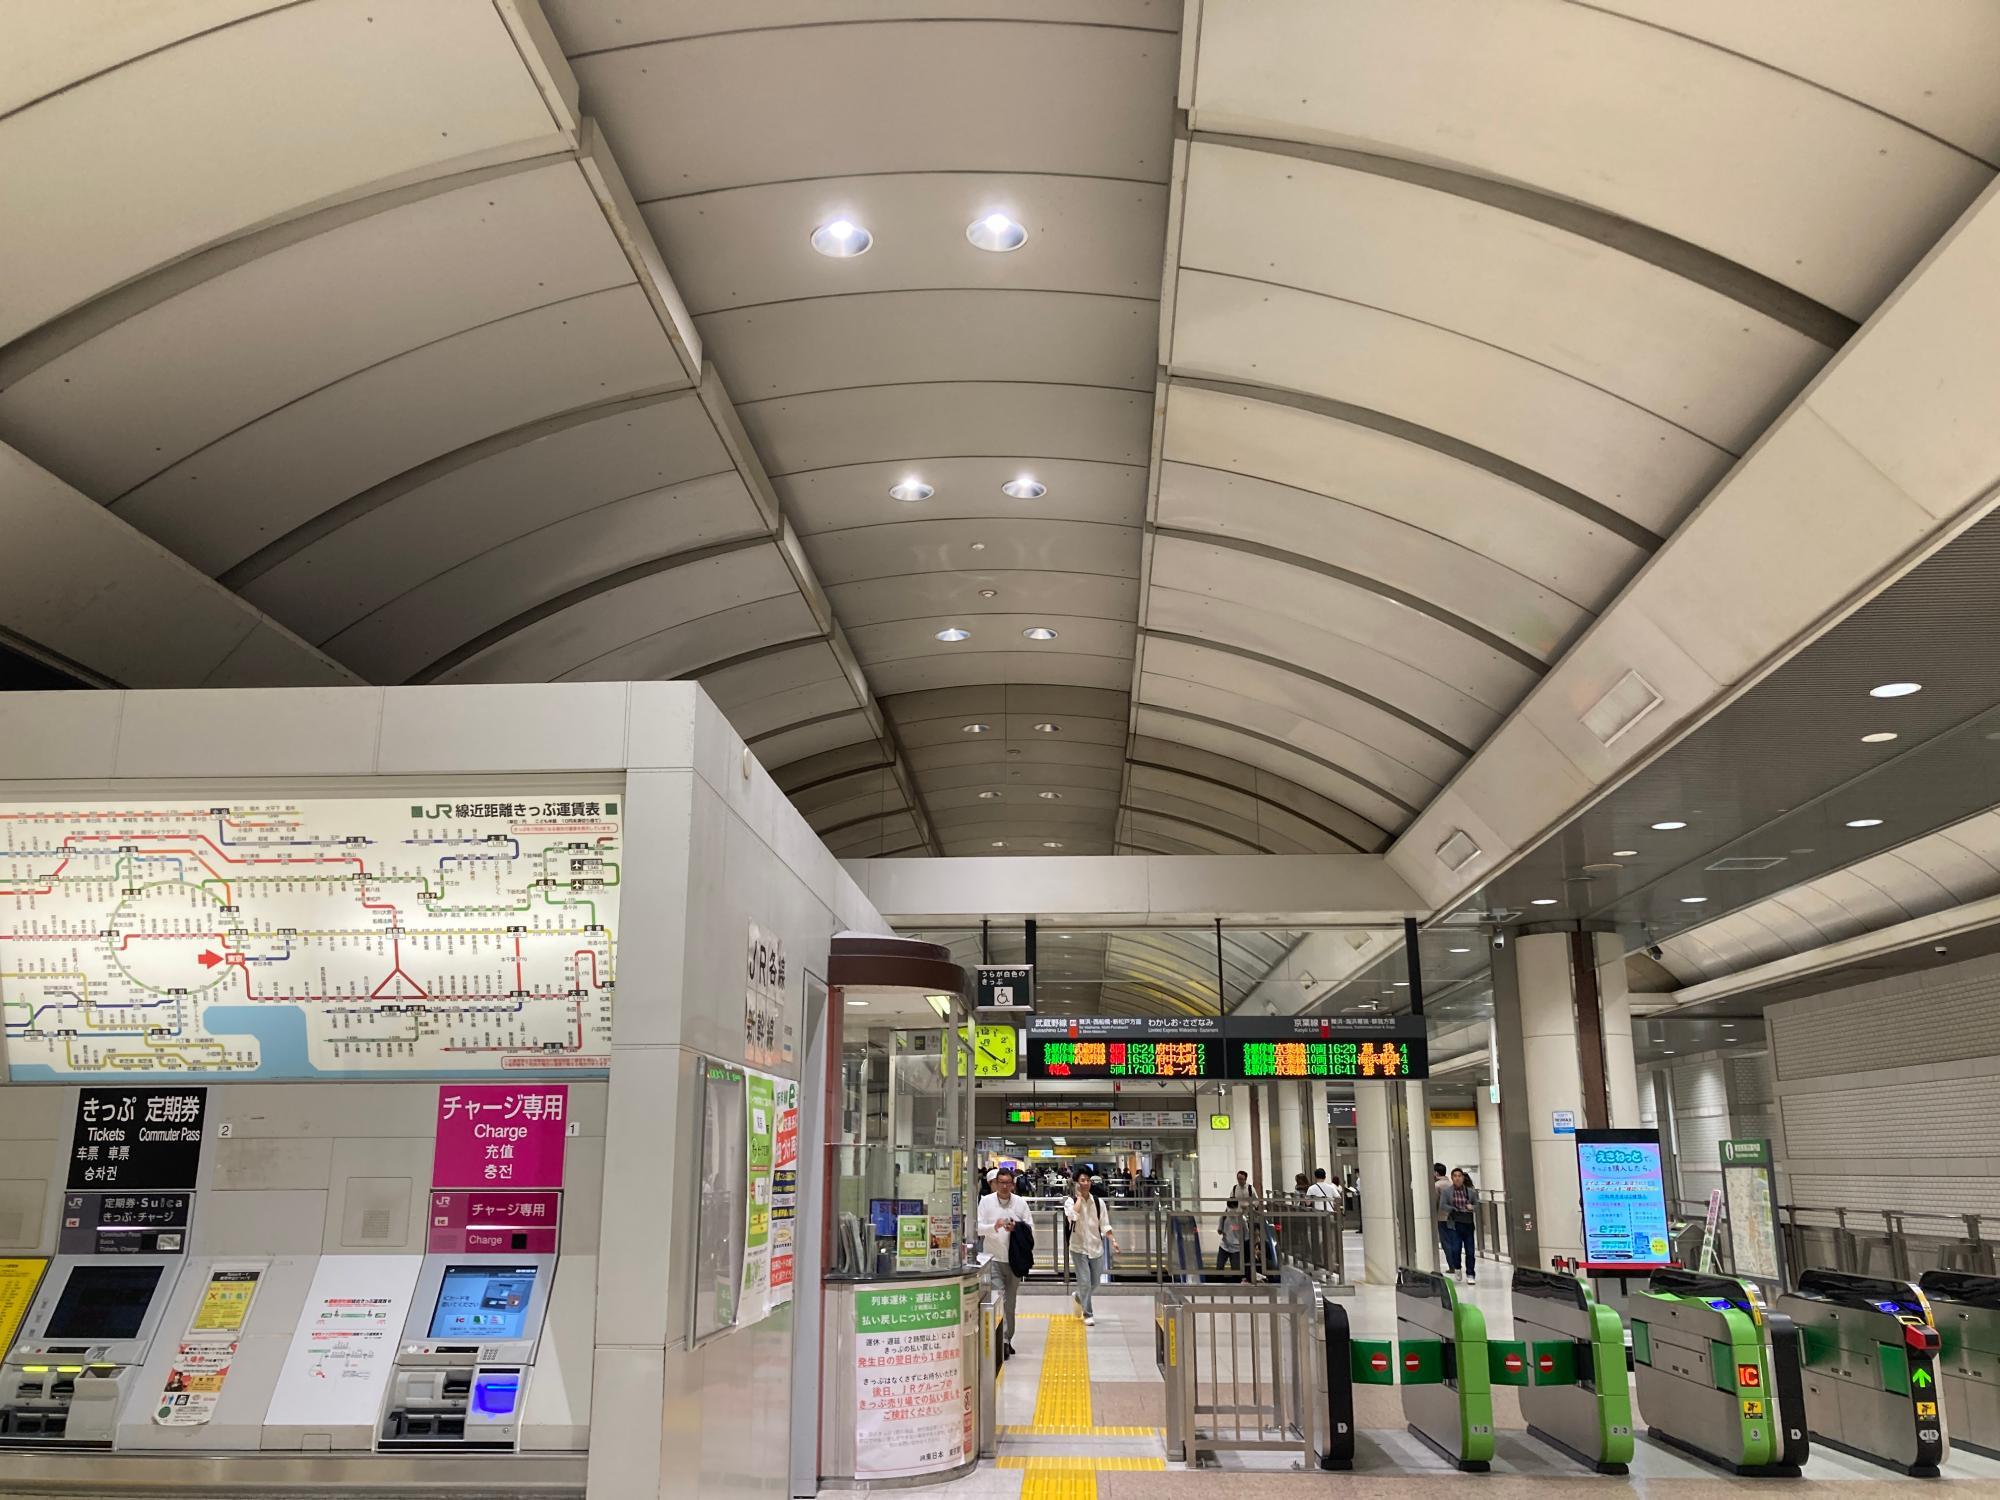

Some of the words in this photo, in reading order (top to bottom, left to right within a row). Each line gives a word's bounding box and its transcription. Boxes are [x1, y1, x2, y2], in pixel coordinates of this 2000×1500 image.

[425, 802, 600, 819] JR線近距離きっぷ運賃表
[1127, 1043, 1155, 1054] 16:24
[1155, 1043, 1197, 1054] 府中本町
[1198, 1043, 1205, 1054] 2
[1328, 1043, 1357, 1054] 16:29
[1400, 1043, 1409, 1054] 4
[1127, 1053, 1155, 1065] 16:52
[1155, 1053, 1197, 1065] 府中本町
[1198, 1053, 1205, 1065] 2
[1328, 1053, 1357, 1065] 16:34
[1400, 1053, 1409, 1065] 4
[1127, 1064, 1155, 1075] 17:00
[1155, 1064, 1198, 1075] 上総一ノ宮
[1199, 1064, 1205, 1075] 1
[1328, 1064, 1357, 1075] 16:41
[1400, 1064, 1409, 1075] 3
[83, 1096, 137, 1122] きっぷ
[144, 1095, 200, 1122] 定期券
[442, 1093, 564, 1121] チャージ専用
[87, 1127, 126, 1142] Tickets
[139, 1127, 181, 1142] Commuter
[180, 1127, 201, 1141] Pass
[221, 1125, 230, 1136] 2
[474, 1123, 528, 1142] Charge
[569, 1124, 575, 1135] 1
[107, 1145, 131, 1161] 車票
[84, 1165, 118, 1181] 승차권
[484, 1163, 513, 1180] 충전
[68, 1197, 83, 1207] JR
[436, 1196, 450, 1206] JR
[471, 1203, 545, 1217] チャージ専用
[103, 1211, 175, 1223] きっぷ・チャージ
[468, 1235, 503, 1247] Charge
[862, 1308, 959, 1326] 払い戻しについてのご案内
[1740, 1367, 1759, 1386] IC
